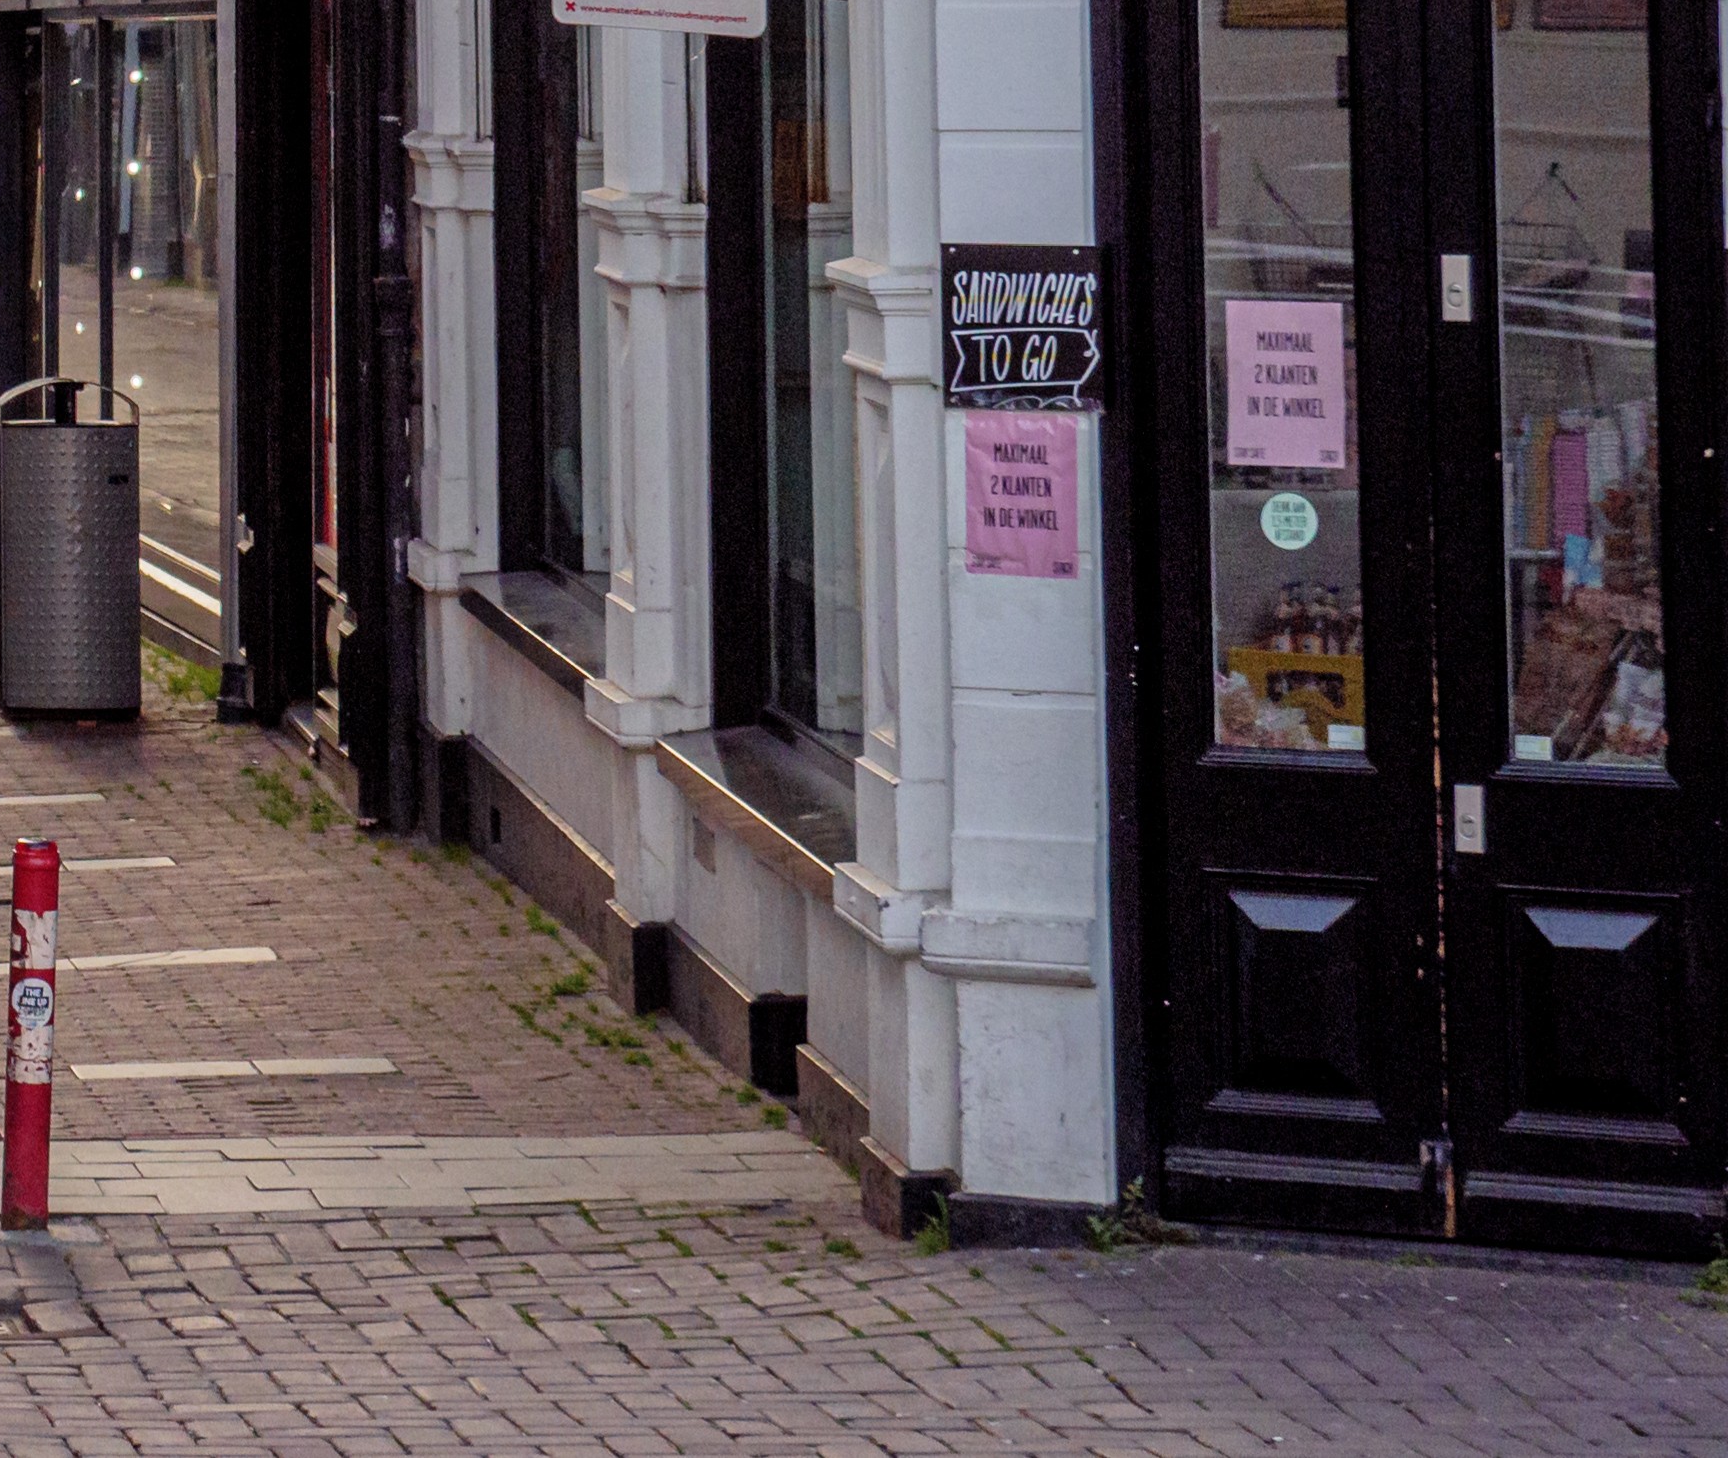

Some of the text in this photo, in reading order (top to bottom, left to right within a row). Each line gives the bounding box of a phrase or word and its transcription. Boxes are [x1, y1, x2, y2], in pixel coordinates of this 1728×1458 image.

[580, 4, 748, 24] www.amsterdam.nl/crowdmanagement
[952, 270, 1097, 327] SANDWICHES
[1256, 331, 1315, 353] MAXIMAAL
[971, 334, 1058, 383] TO GO
[1254, 363, 1318, 385] 2 KLANTEN
[1247, 395, 1326, 419] IN DE WINKEL
[994, 443, 1049, 466] MAXIMAAL
[991, 474, 1053, 498] 2 KLANTEN
[984, 506, 1059, 531] IN DE WINKEL
